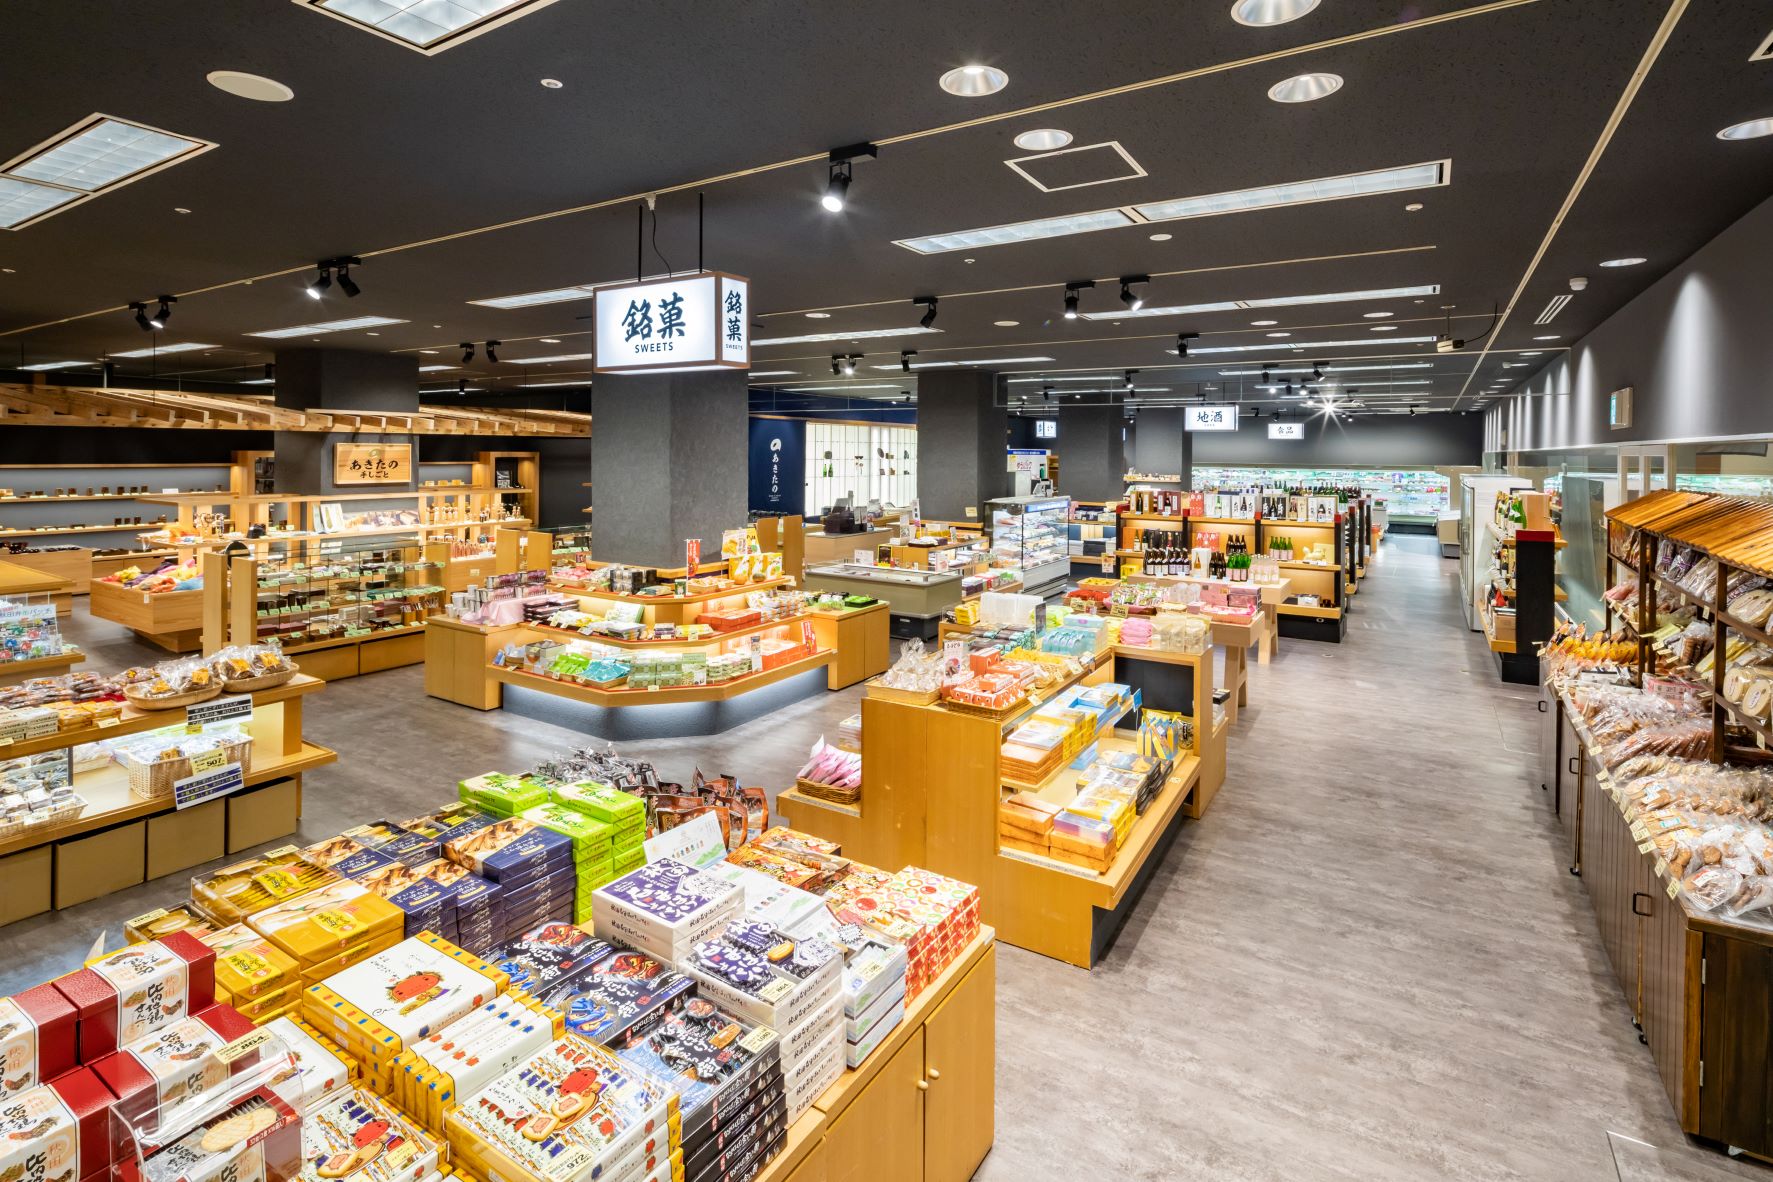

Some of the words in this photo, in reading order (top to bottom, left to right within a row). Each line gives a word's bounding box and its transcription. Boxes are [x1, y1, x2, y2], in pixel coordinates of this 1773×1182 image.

[622, 292, 686, 342] 銘菓
[725, 290, 742, 342] 銘菓
[635, 341, 674, 354] SWEETS
[725, 343, 743, 351] SWEETS
[1197, 411, 1223, 423] 地酒
[350, 459, 399, 471] あきたの
[206, 757, 222, 768] 507
[566, 1152, 588, 1171] 972
